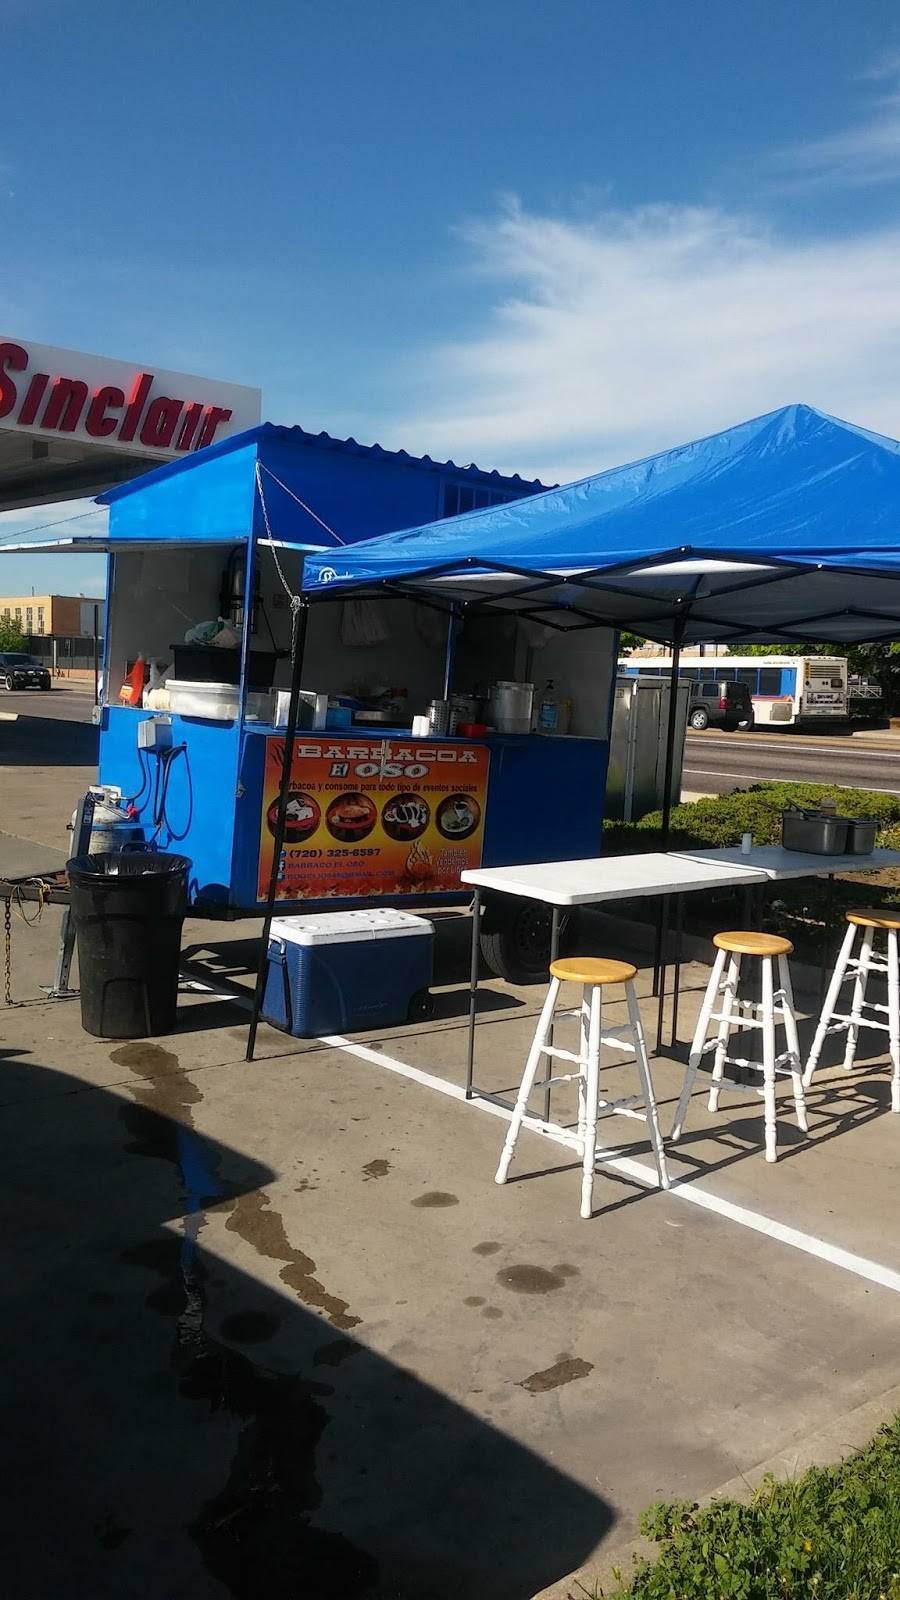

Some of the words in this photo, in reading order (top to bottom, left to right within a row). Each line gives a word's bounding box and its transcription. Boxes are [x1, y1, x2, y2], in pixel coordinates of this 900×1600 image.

[0, 342, 233, 451] Sinclair
[298, 744, 477, 763] BARBACOA
[355, 762, 430, 779] OSO
[319, 783, 323, 793] y
[361, 784, 377, 792] para
[379, 782, 396, 793] todo
[398, 783, 411, 793] tipo
[413, 783, 421, 793] de
[423, 783, 450, 794] eventos
[452, 783, 478, 794] sociales
[289, 848, 323, 859] (720)
